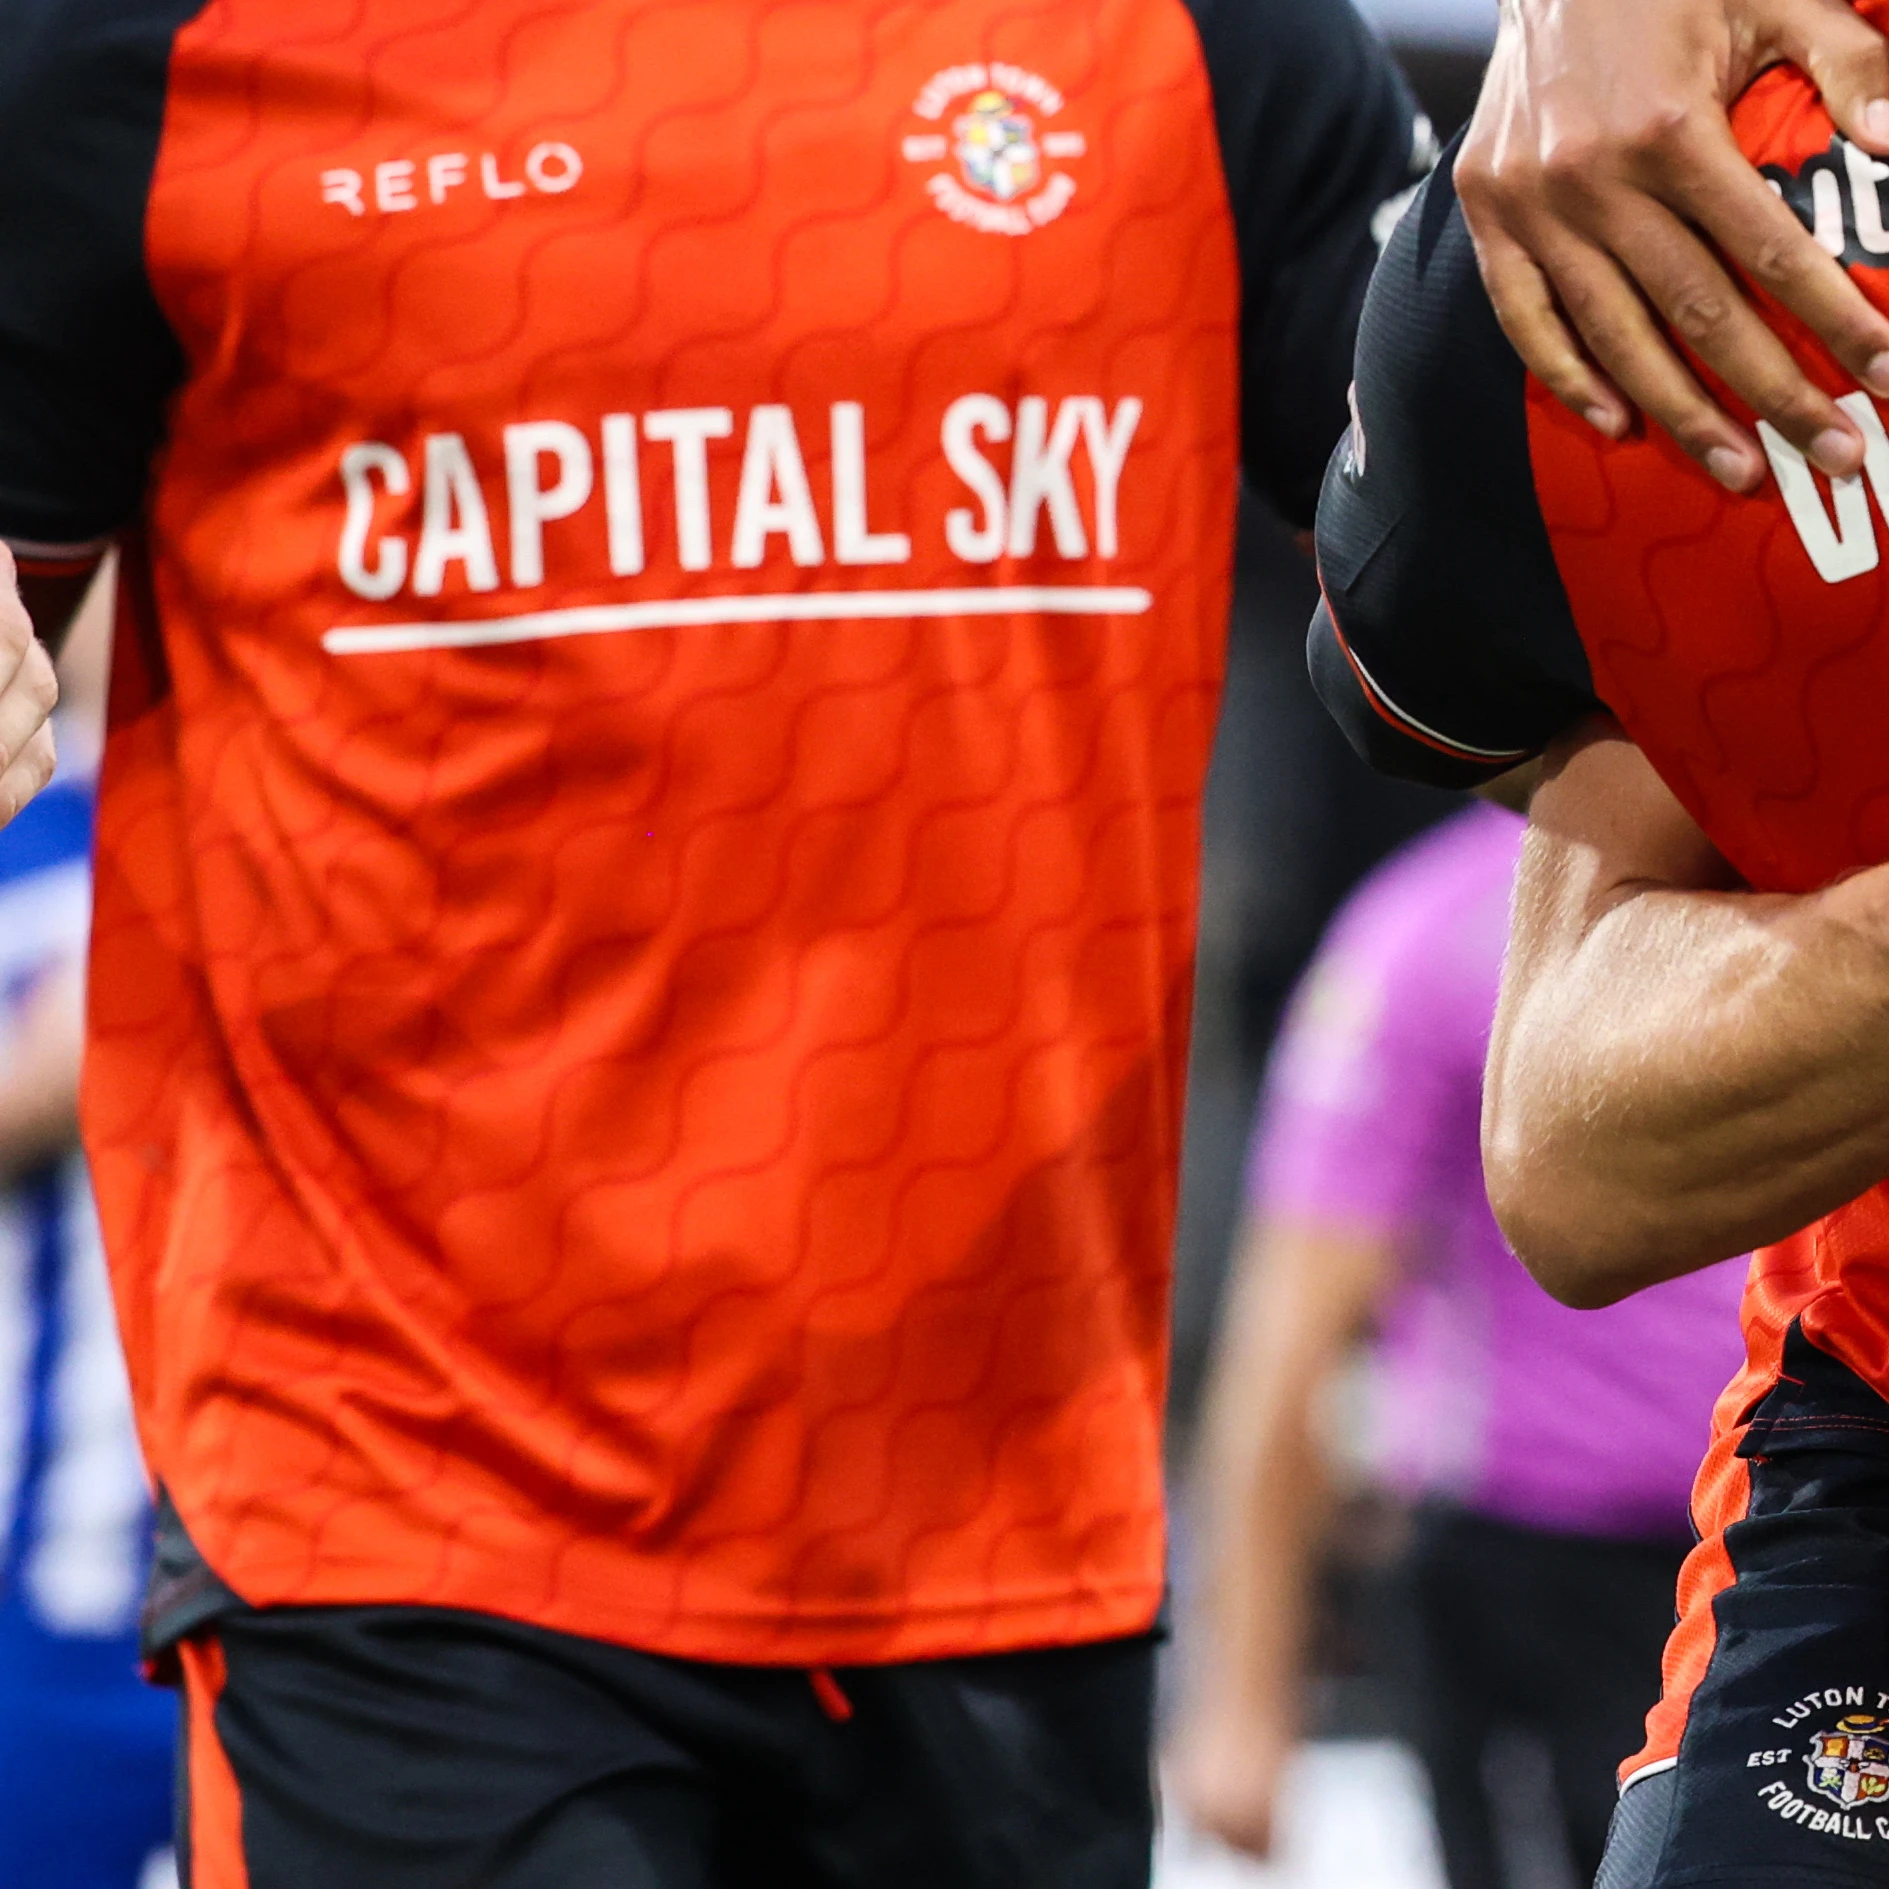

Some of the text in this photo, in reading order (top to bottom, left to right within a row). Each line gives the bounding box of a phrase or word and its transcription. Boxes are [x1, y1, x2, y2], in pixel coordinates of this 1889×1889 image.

[322, 142, 582, 217] REFLO
[337, 393, 1143, 601] CAPITAL SKY
[1772, 1686, 1864, 1729] LUTON
[1746, 1749, 1792, 1767] EST
[1757, 1780, 1872, 1840] FOOTBALL
